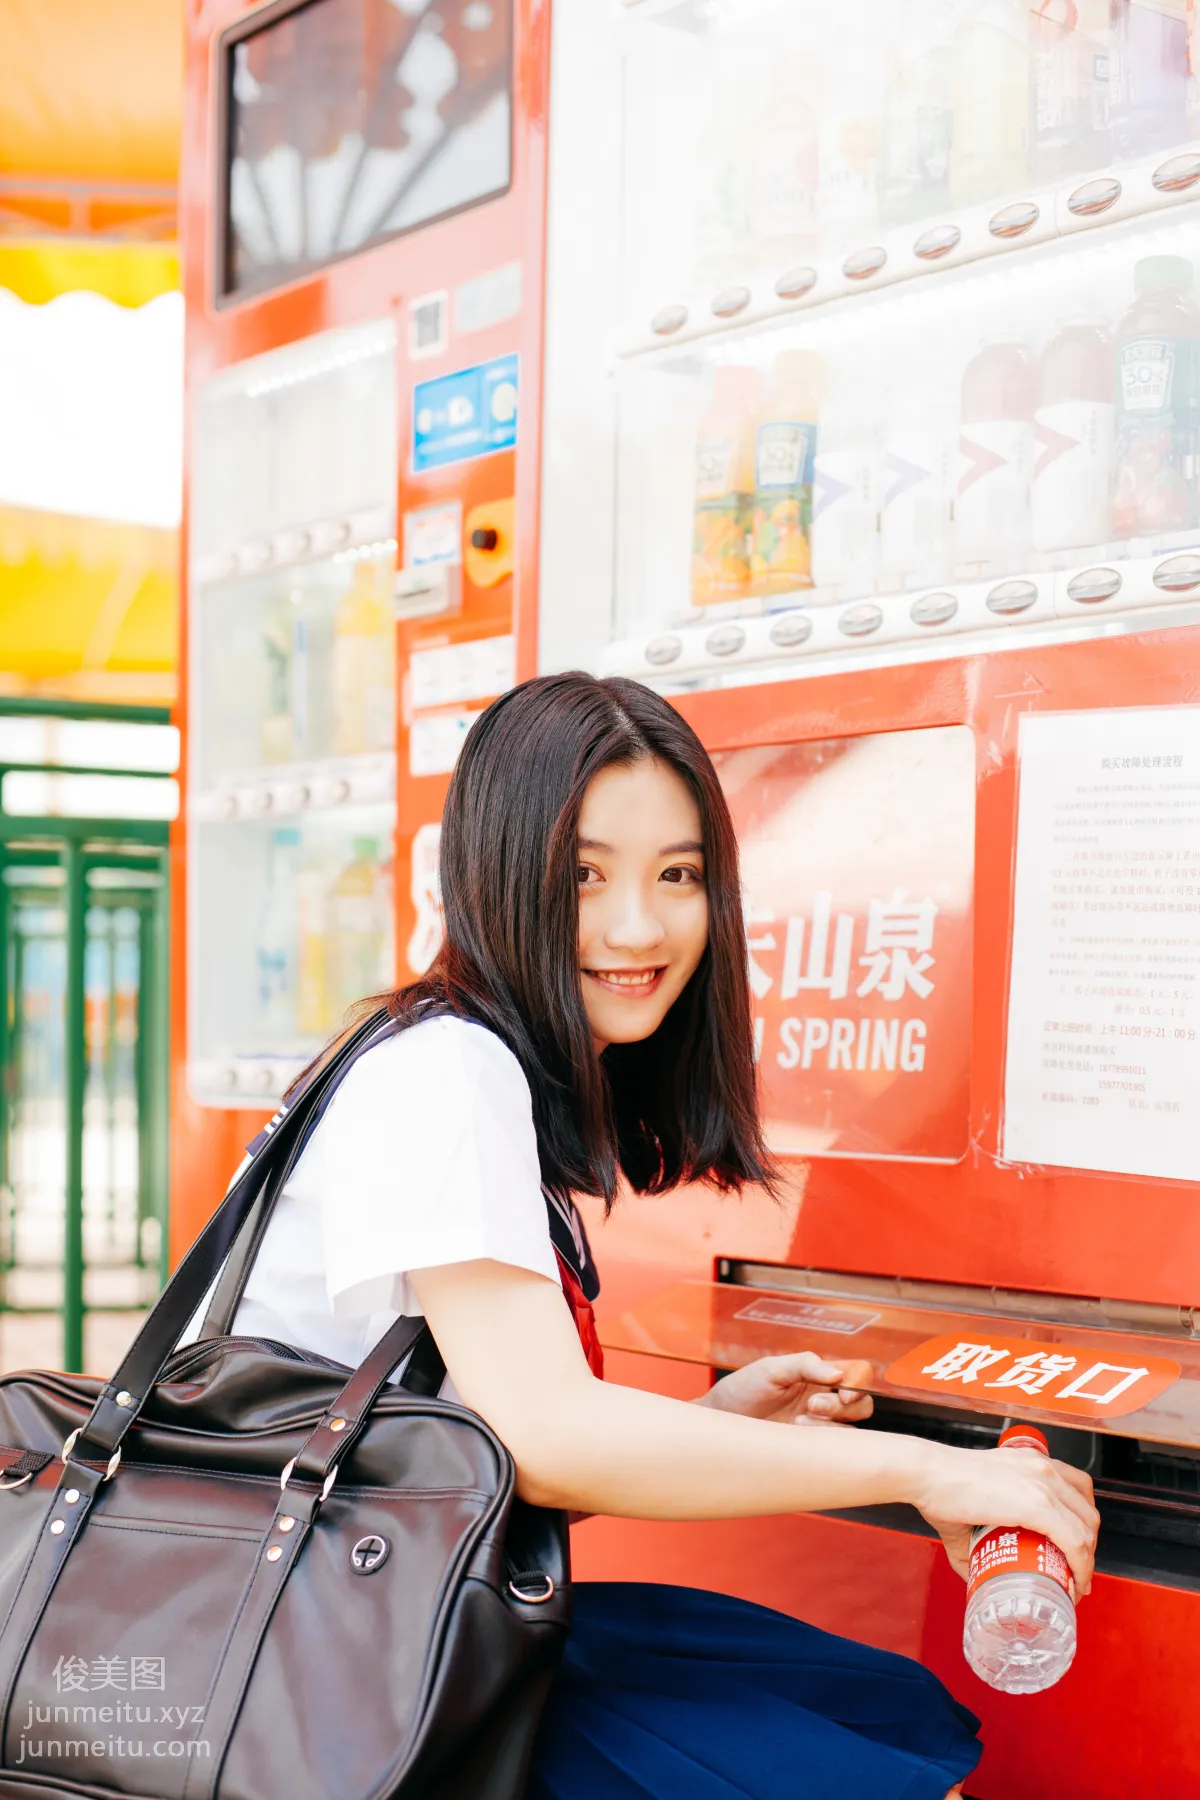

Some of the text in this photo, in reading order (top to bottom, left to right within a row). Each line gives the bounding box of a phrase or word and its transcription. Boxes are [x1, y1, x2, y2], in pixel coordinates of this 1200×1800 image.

[1101, 755, 1184, 769] 购买故障处理流程
[777, 1016, 928, 1073] SPRING
[921, 1341, 1150, 1405] 取货口
[981, 1547, 1018, 1567] SPRING
